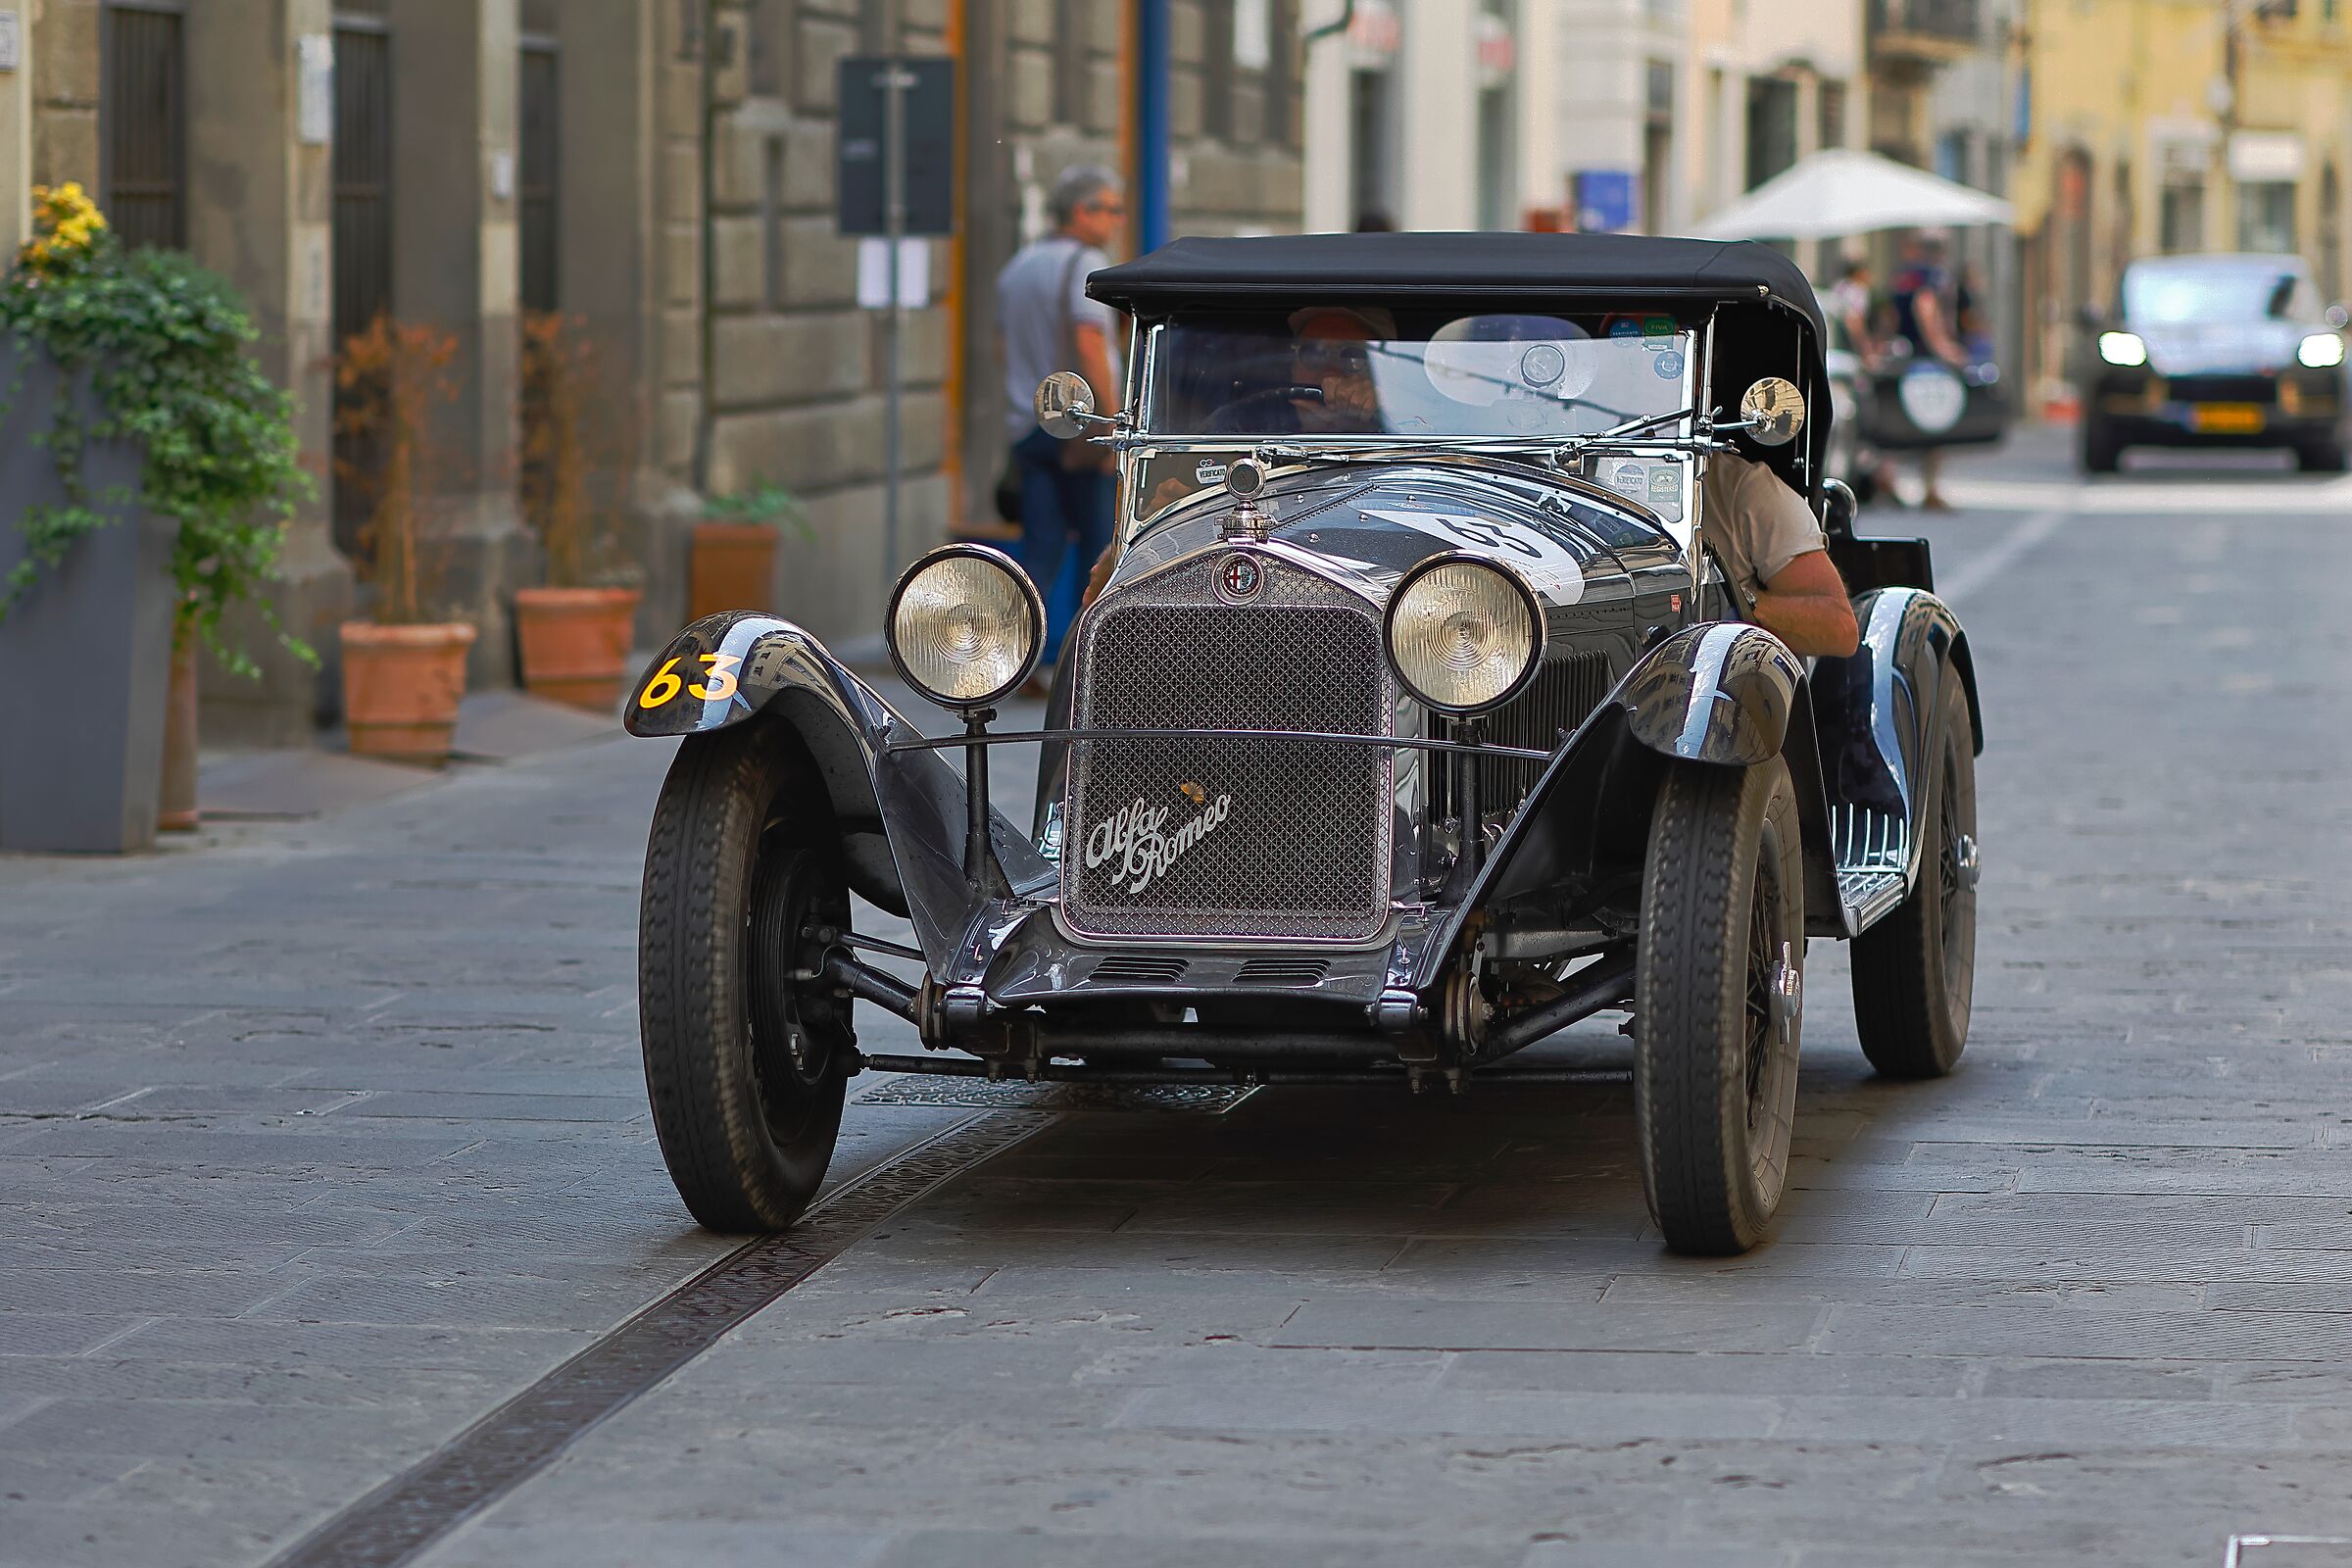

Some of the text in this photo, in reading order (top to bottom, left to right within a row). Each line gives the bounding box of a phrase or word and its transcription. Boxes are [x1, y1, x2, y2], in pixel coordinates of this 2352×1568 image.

[1650, 484, 1679, 494] REGISTERED
[1435, 517, 1543, 559] 63
[639, 653, 742, 710] 63
[1085, 794, 1232, 895] Alfa Romeo
